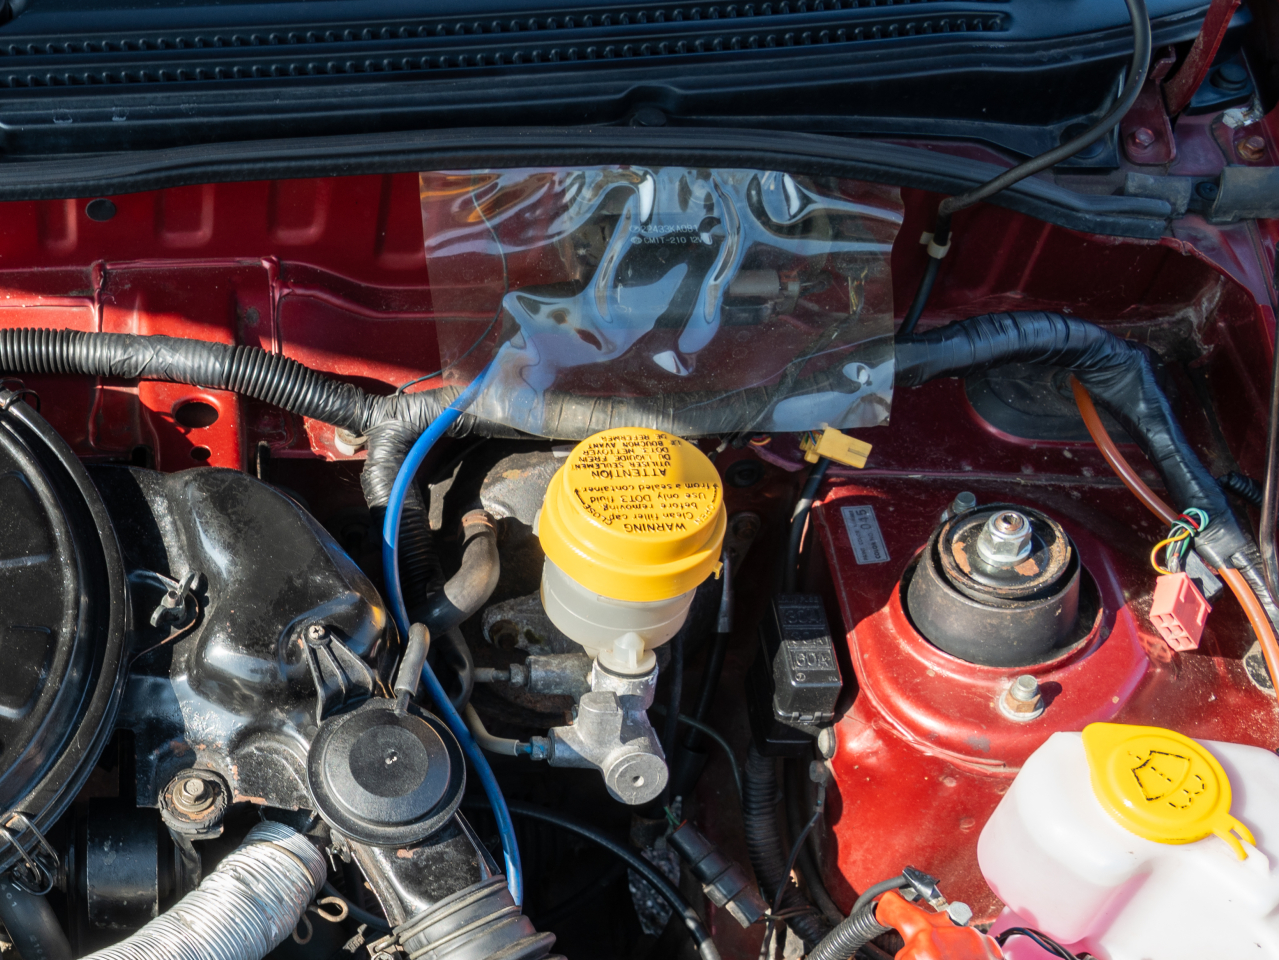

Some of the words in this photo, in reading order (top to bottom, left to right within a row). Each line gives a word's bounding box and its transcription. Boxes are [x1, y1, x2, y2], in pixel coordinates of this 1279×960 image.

[592, 468, 667, 479] ATTENTION
[638, 483, 672, 491] sealed
[589, 495, 615, 504] fluid
[657, 492, 679, 500] only
[660, 502, 698, 510] before
[633, 511, 659, 521] filler
[662, 511, 694, 520] Clean
[623, 522, 687, 533] WARNING
